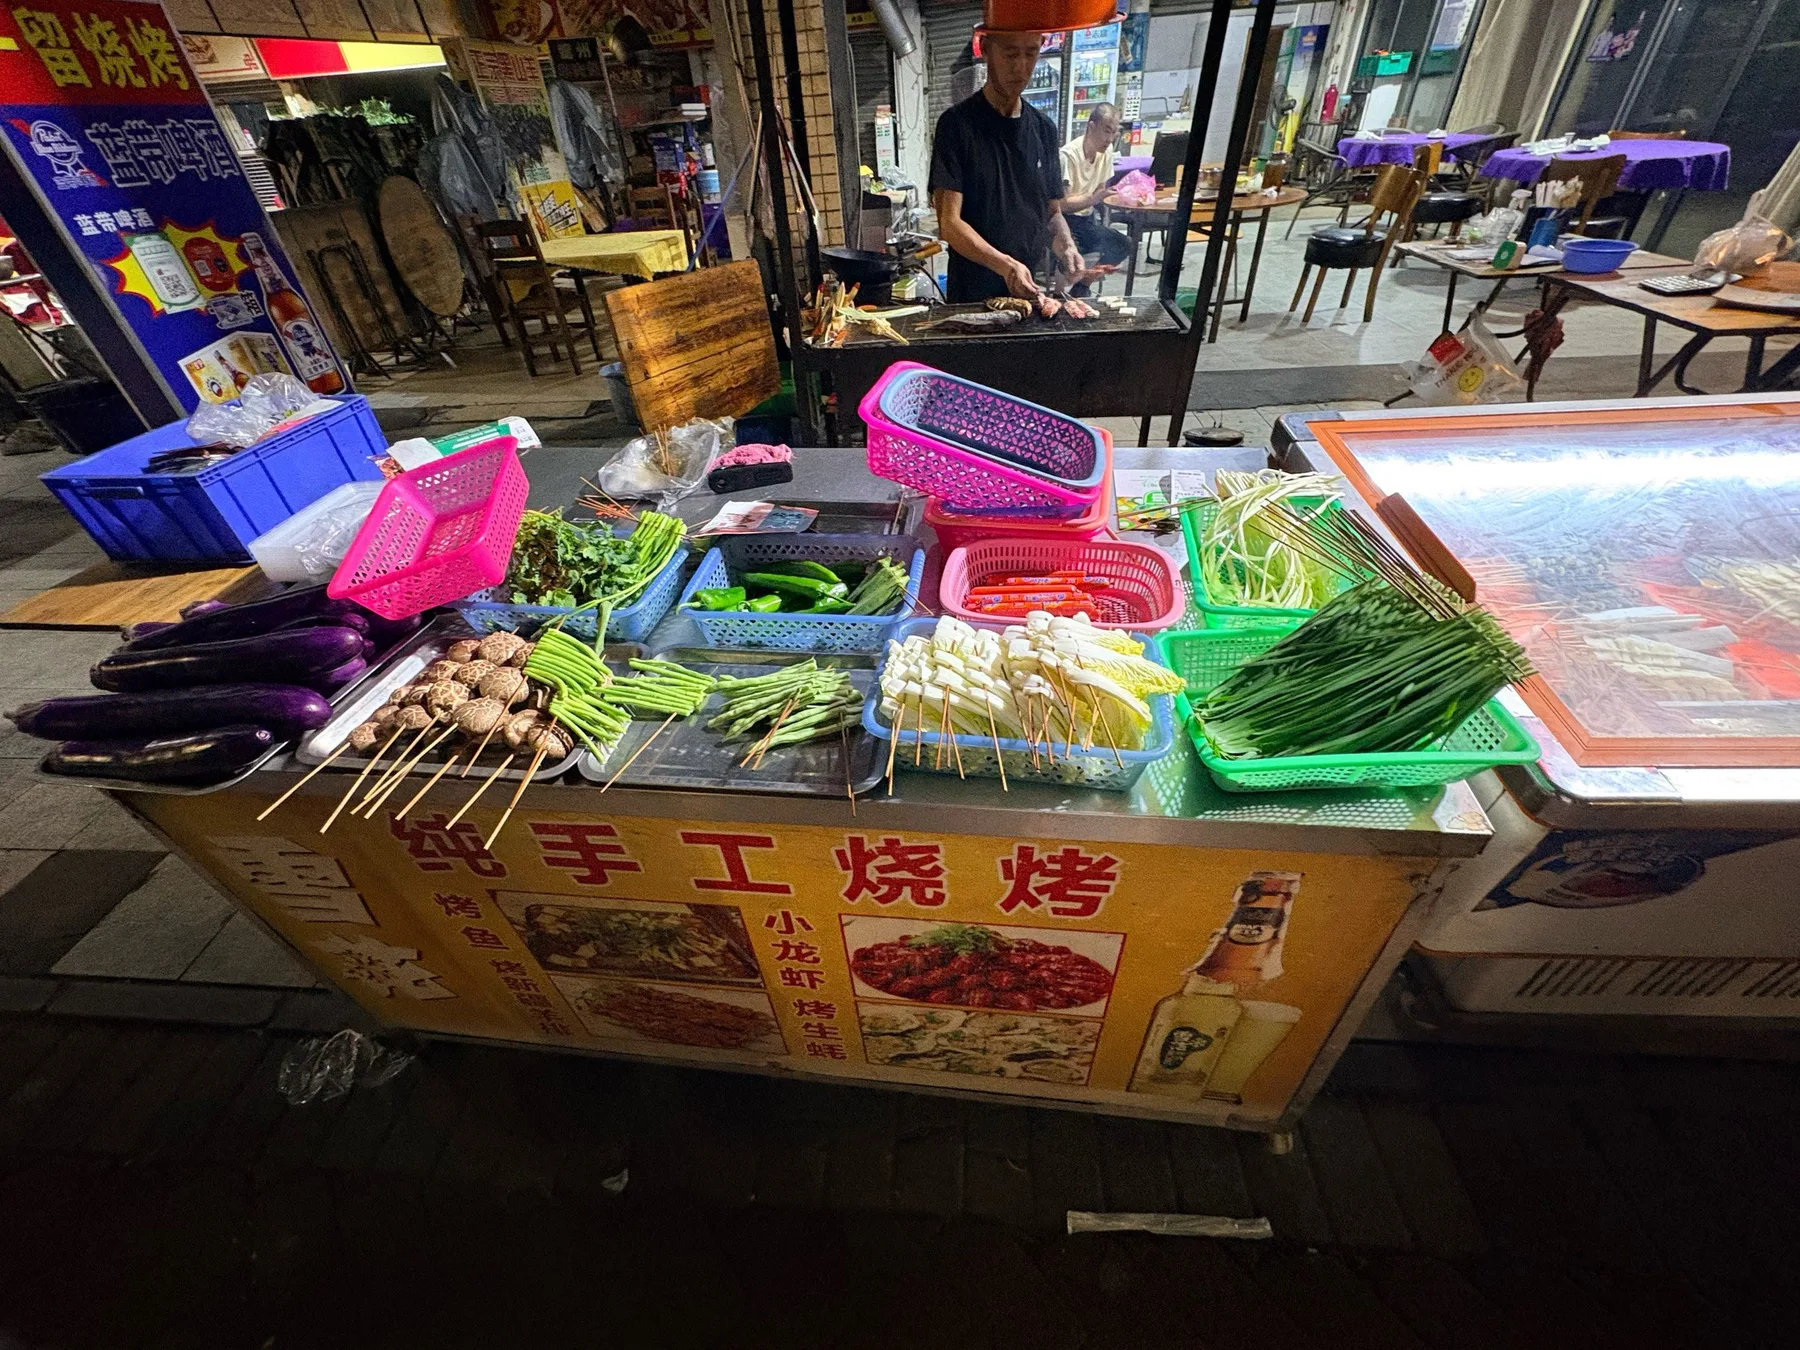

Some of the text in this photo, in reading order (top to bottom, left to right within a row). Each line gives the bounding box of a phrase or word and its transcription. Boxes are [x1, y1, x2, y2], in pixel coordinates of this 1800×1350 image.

[0, 7, 190, 90] 留烧烤
[85, 118, 239, 188] 蓝带啤酒
[73, 207, 155, 236] 蓝带啤酒
[388, 810, 1118, 917] 纯手工烧烤
[434, 893, 510, 950] 烤鱼
[764, 910, 848, 1060] 小龙虾 烤生蚝
